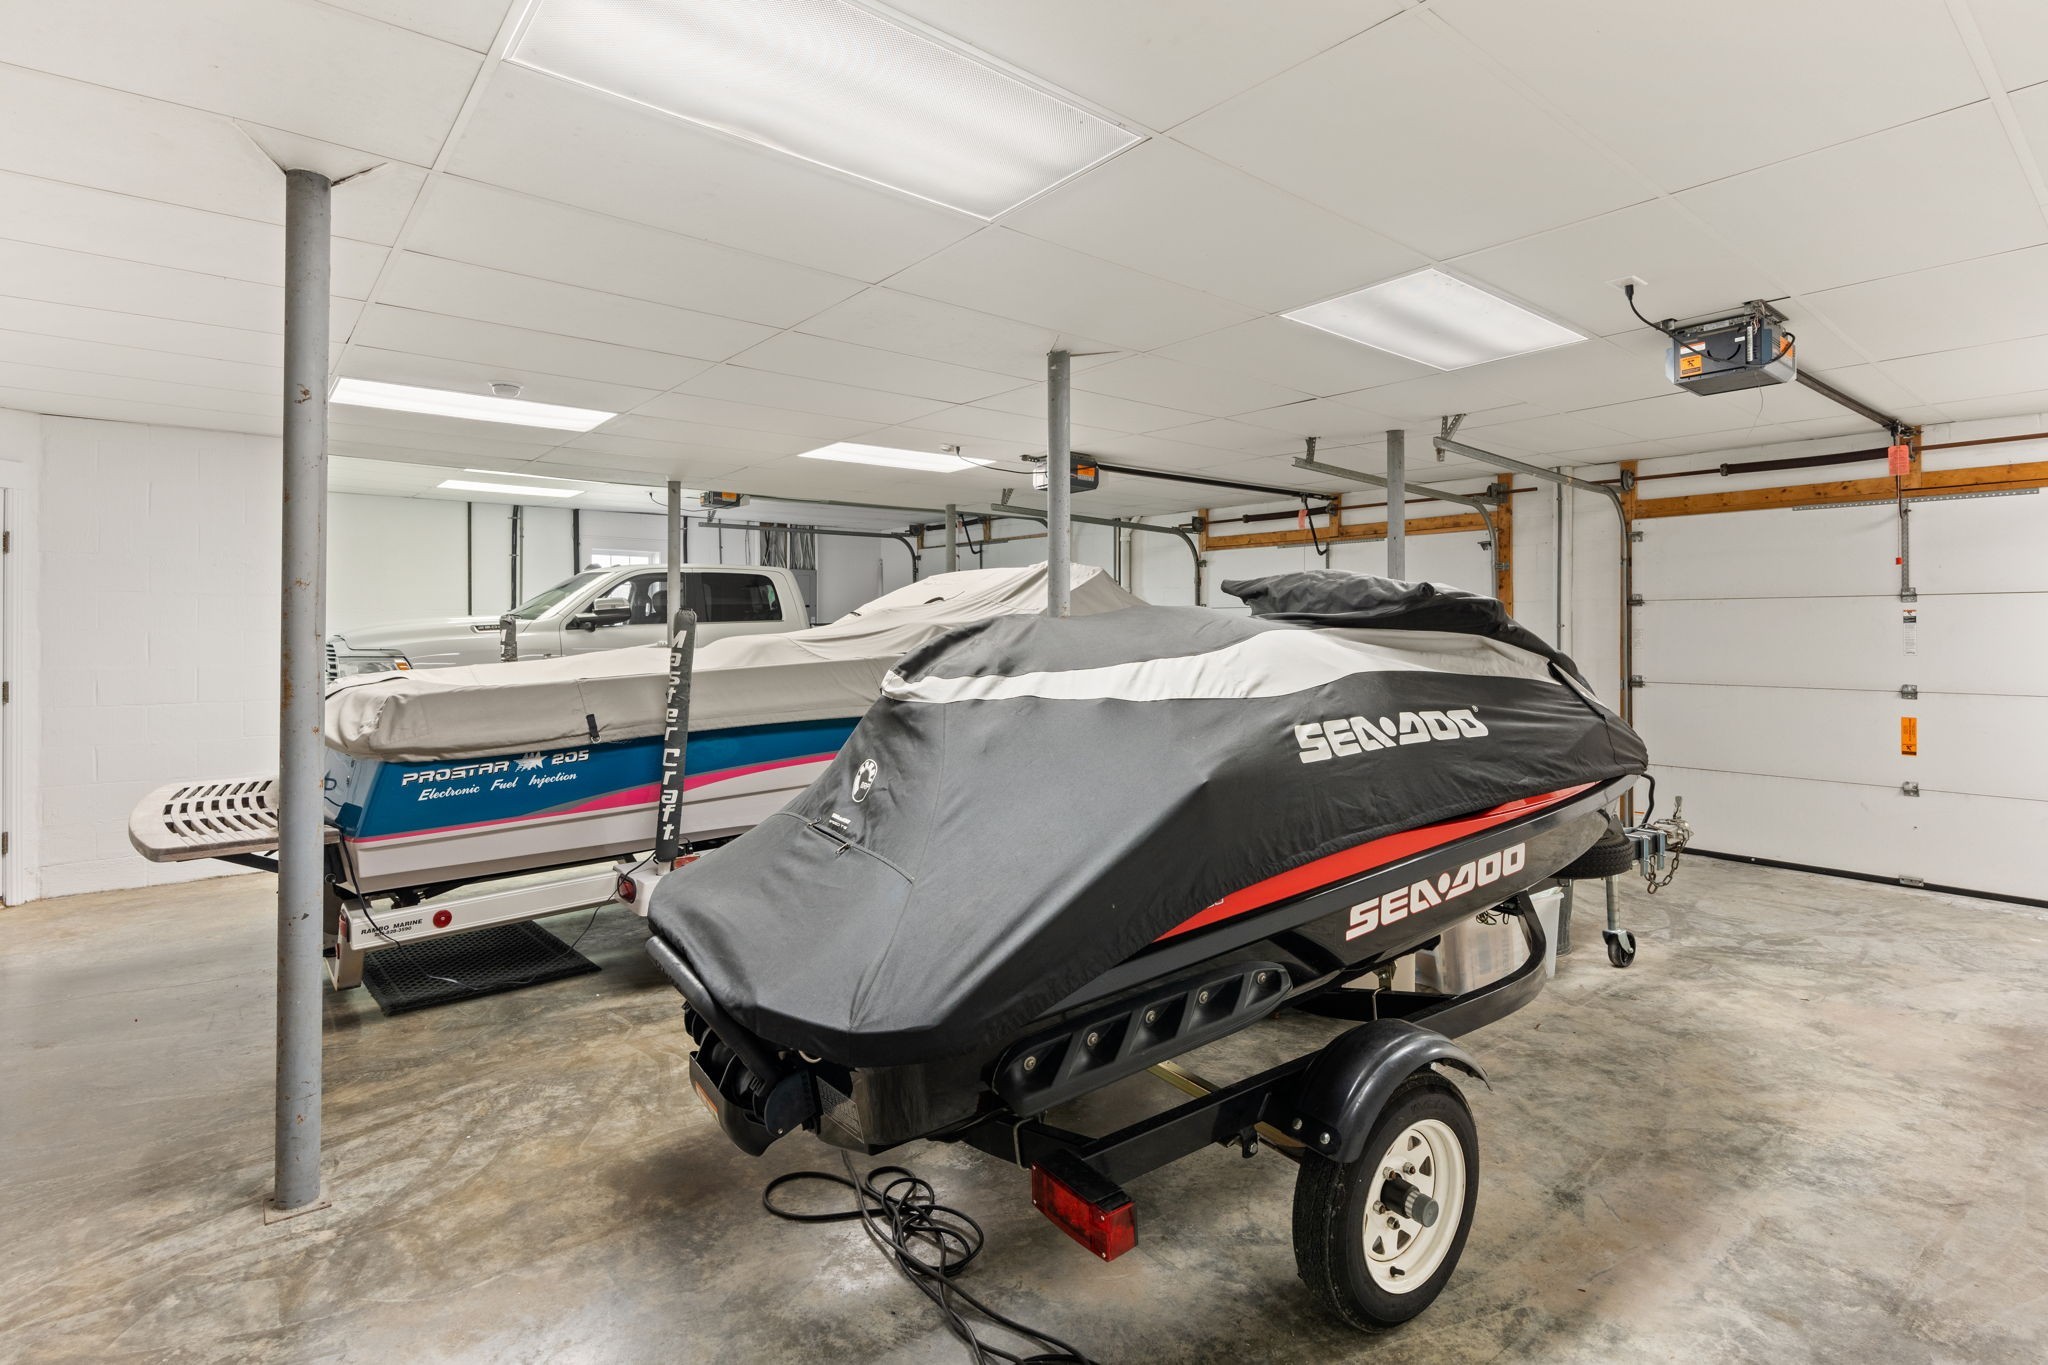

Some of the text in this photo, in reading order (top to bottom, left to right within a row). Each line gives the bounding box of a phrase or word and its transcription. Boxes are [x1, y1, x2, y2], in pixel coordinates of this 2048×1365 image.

[401, 750, 590, 787] PROSTAR 205
[417, 771, 578, 802] Electronic Fuel Injection
[360, 918, 423, 935] RAMBO MARINE
